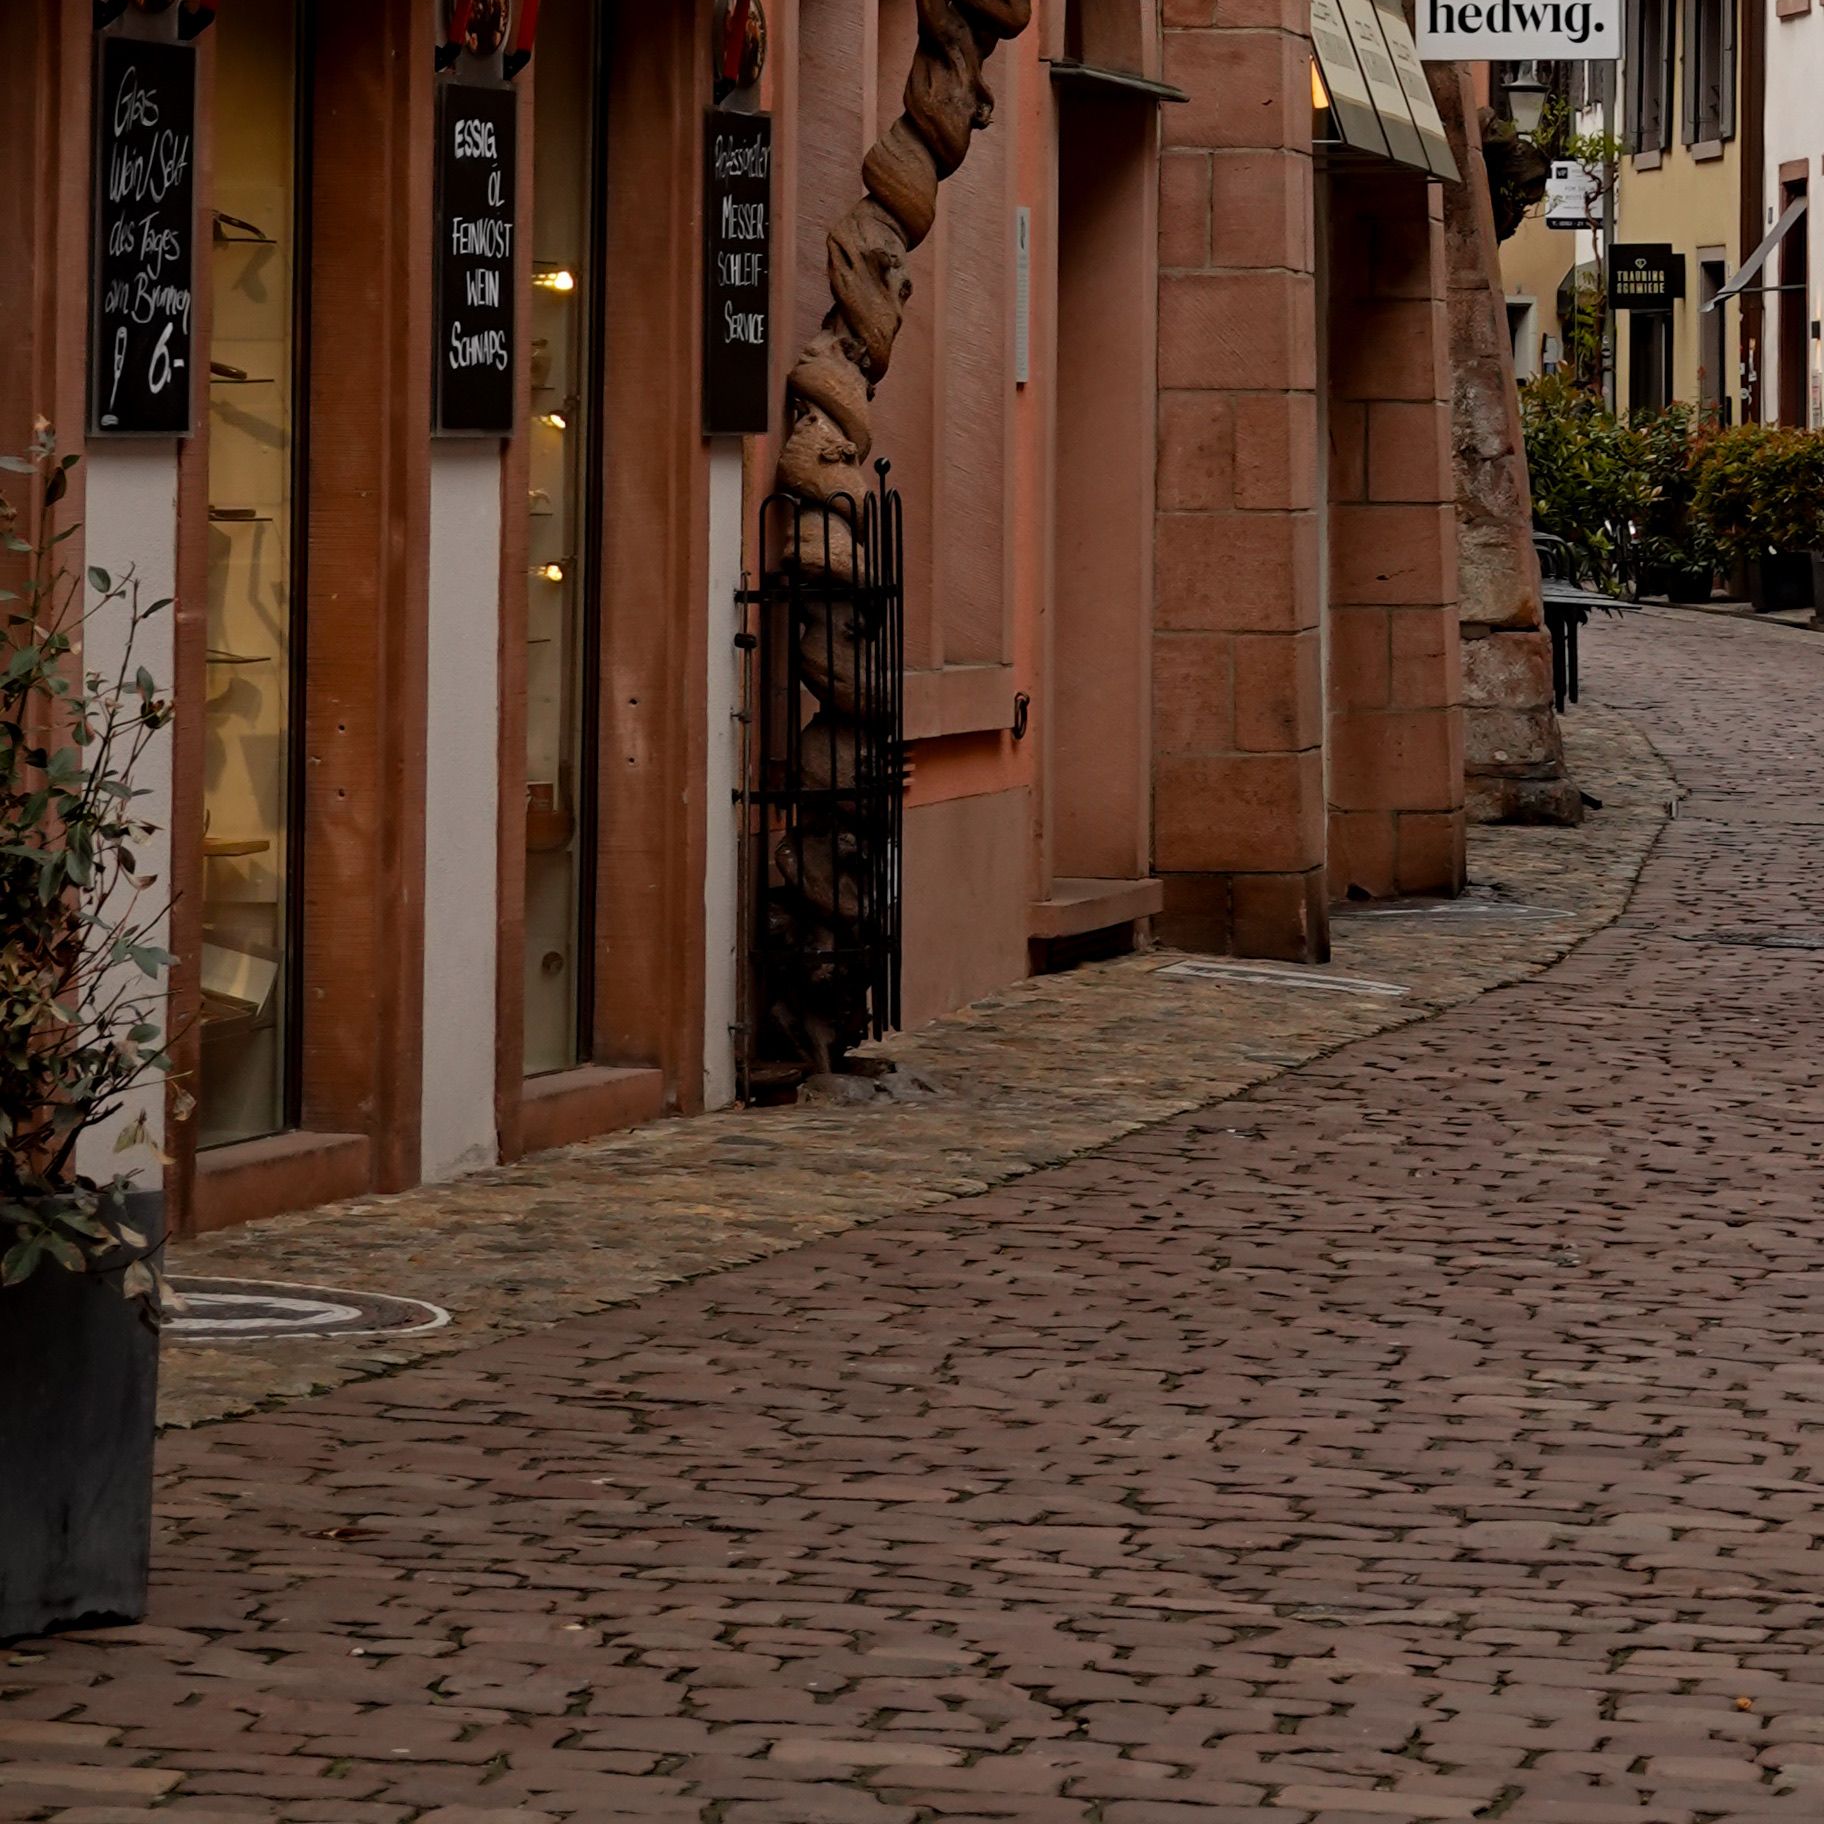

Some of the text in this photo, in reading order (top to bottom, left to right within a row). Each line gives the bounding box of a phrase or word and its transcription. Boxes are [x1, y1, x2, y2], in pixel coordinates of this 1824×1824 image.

[115, 65, 159, 137] Glas
[455, 119, 497, 159] ESSIG
[109, 208, 181, 281] des Tages
[452, 217, 513, 258] FEINKOST
[105, 279, 129, 314] am
[466, 268, 499, 307] WEIN
